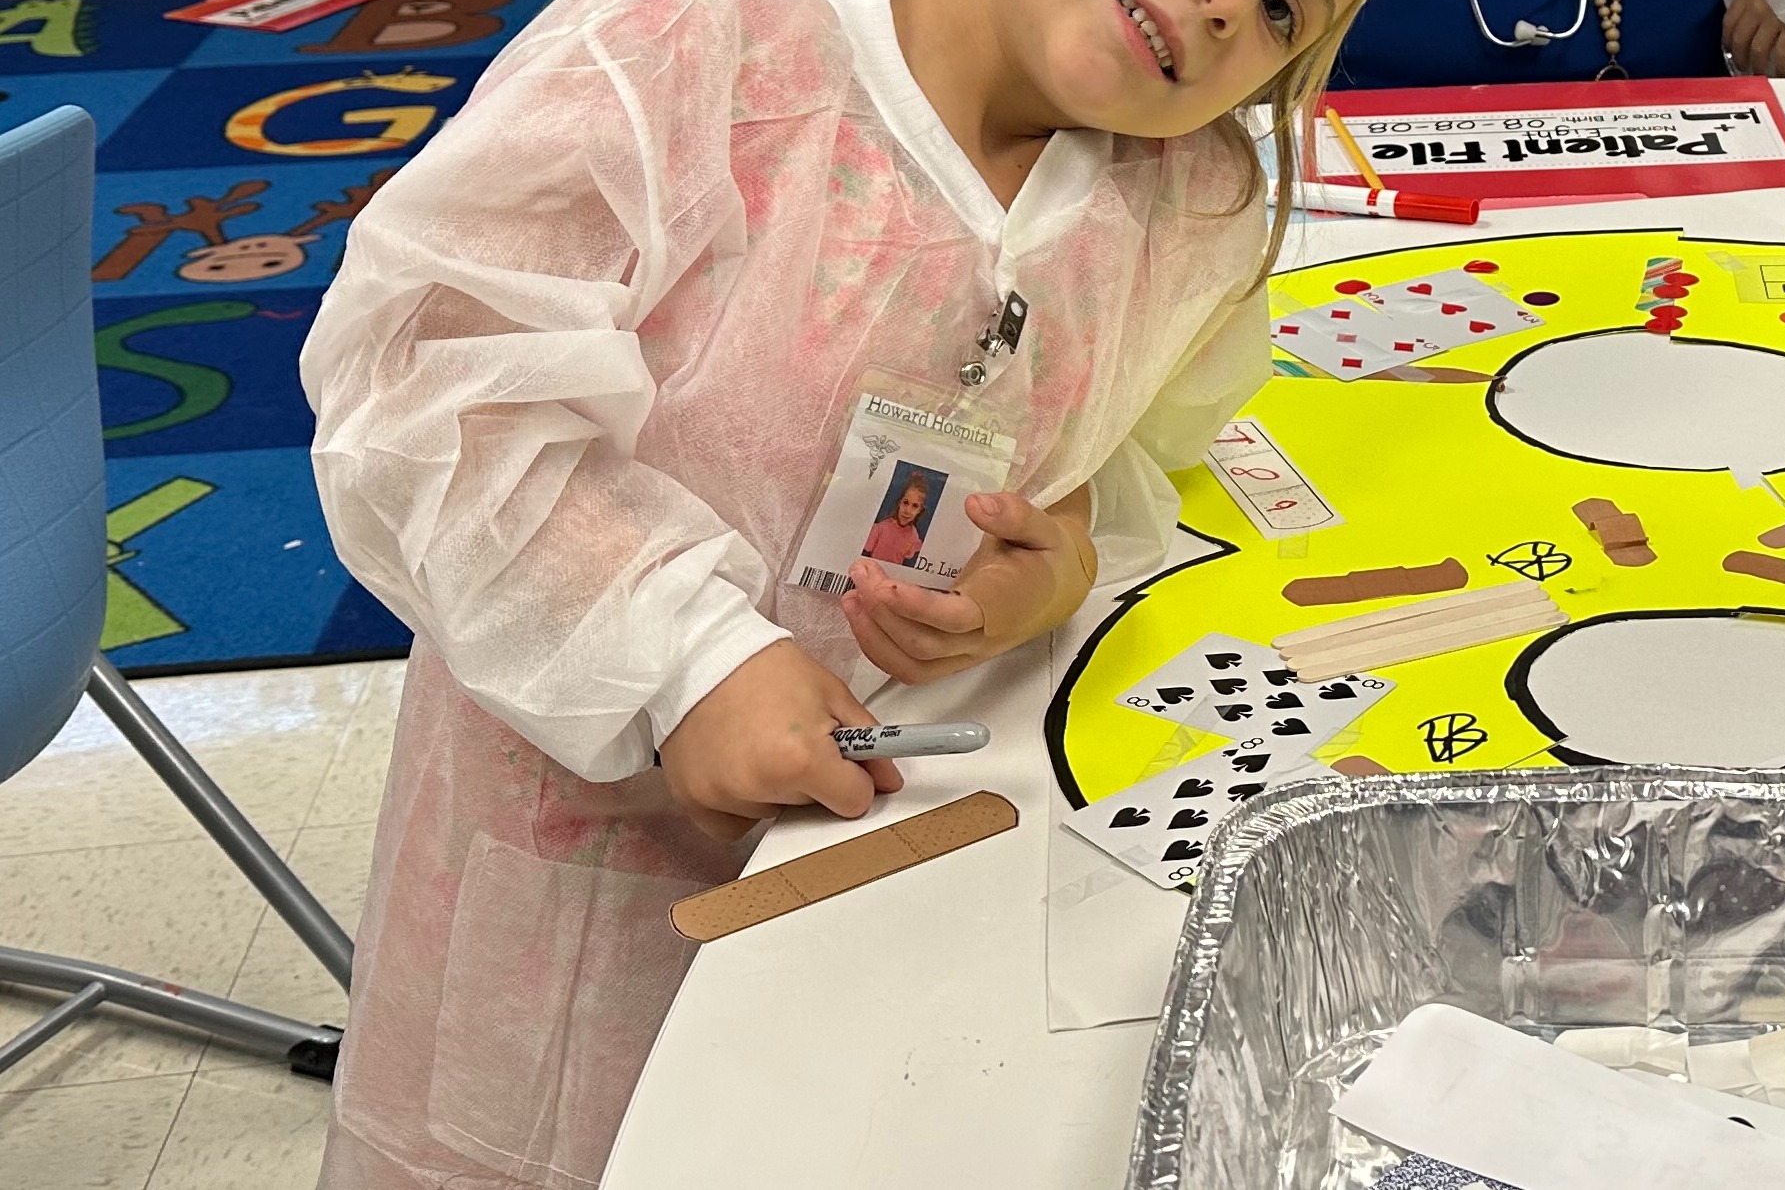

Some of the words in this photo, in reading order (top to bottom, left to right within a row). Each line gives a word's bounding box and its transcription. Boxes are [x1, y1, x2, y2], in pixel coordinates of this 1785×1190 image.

[225, 68, 456, 156] G
[1560, 114, 1605, 123] Birth:
[1646, 111, 1672, 120] Date
[1622, 124, 1677, 133] Name:
[1372, 140, 1488, 164] File
[1502, 130, 1729, 162] Patient
[866, 396, 931, 428] Howard
[932, 415, 996, 447] Hospital
[1229, 466, 1281, 481] 8
[916, 556, 935, 574] Dr.
[1361, 678, 1386, 691] 8
[1126, 696, 1151, 708] 8
[1240, 736, 1265, 750] 8
[1168, 866, 1194, 882] 8
